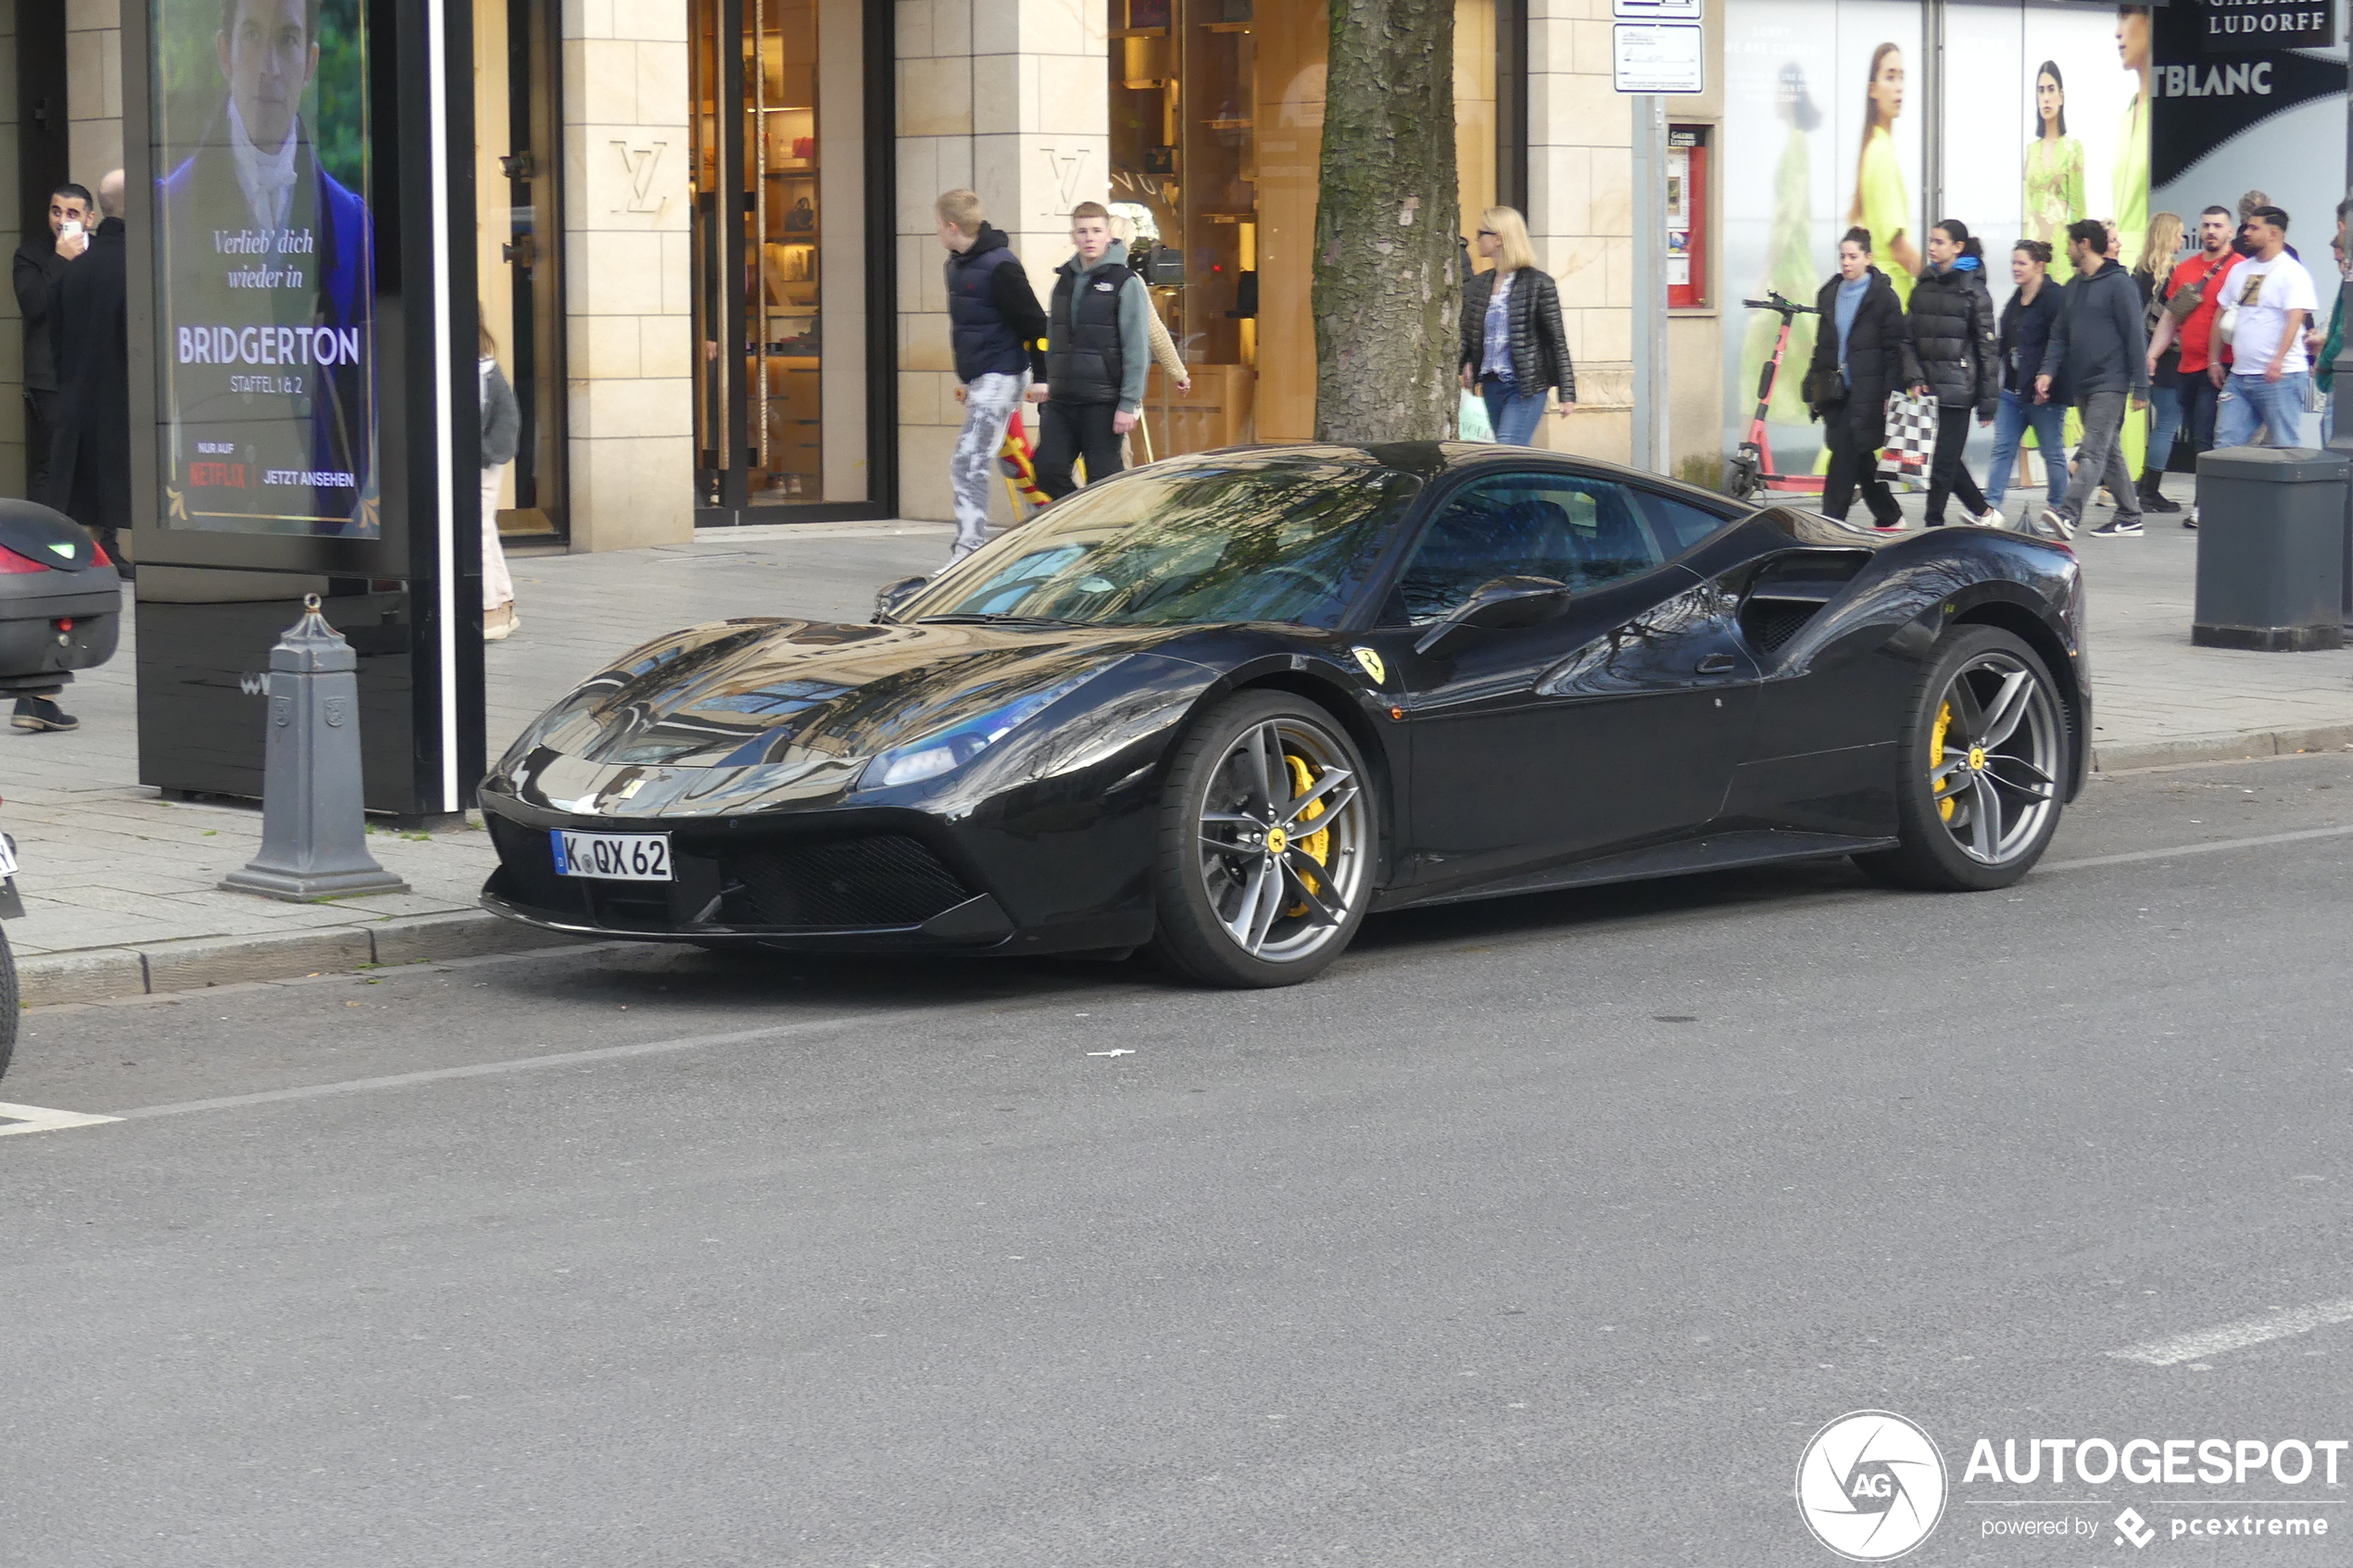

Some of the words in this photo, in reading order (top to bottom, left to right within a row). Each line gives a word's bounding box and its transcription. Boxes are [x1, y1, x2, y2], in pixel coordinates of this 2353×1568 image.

[2209, 12, 2325, 34] LUDORFF
[213, 229, 276, 255] Verlieb’
[278, 228, 314, 254] dich
[228, 264, 283, 288] wieder
[285, 264, 303, 288] in
[179, 326, 359, 366] BRIDGERTON
[231, 375, 276, 394] STAFFEL
[278, 376, 283, 394] 1
[283, 377, 293, 394] &
[295, 376, 303, 394] 2
[197, 442, 216, 454] NUR
[217, 443, 234, 454] AUF
[189, 462, 246, 488] NETFLIX
[263, 470, 299, 485] JETZT
[300, 470, 354, 487] ANSEHEN
[564, 836, 582, 872] K
